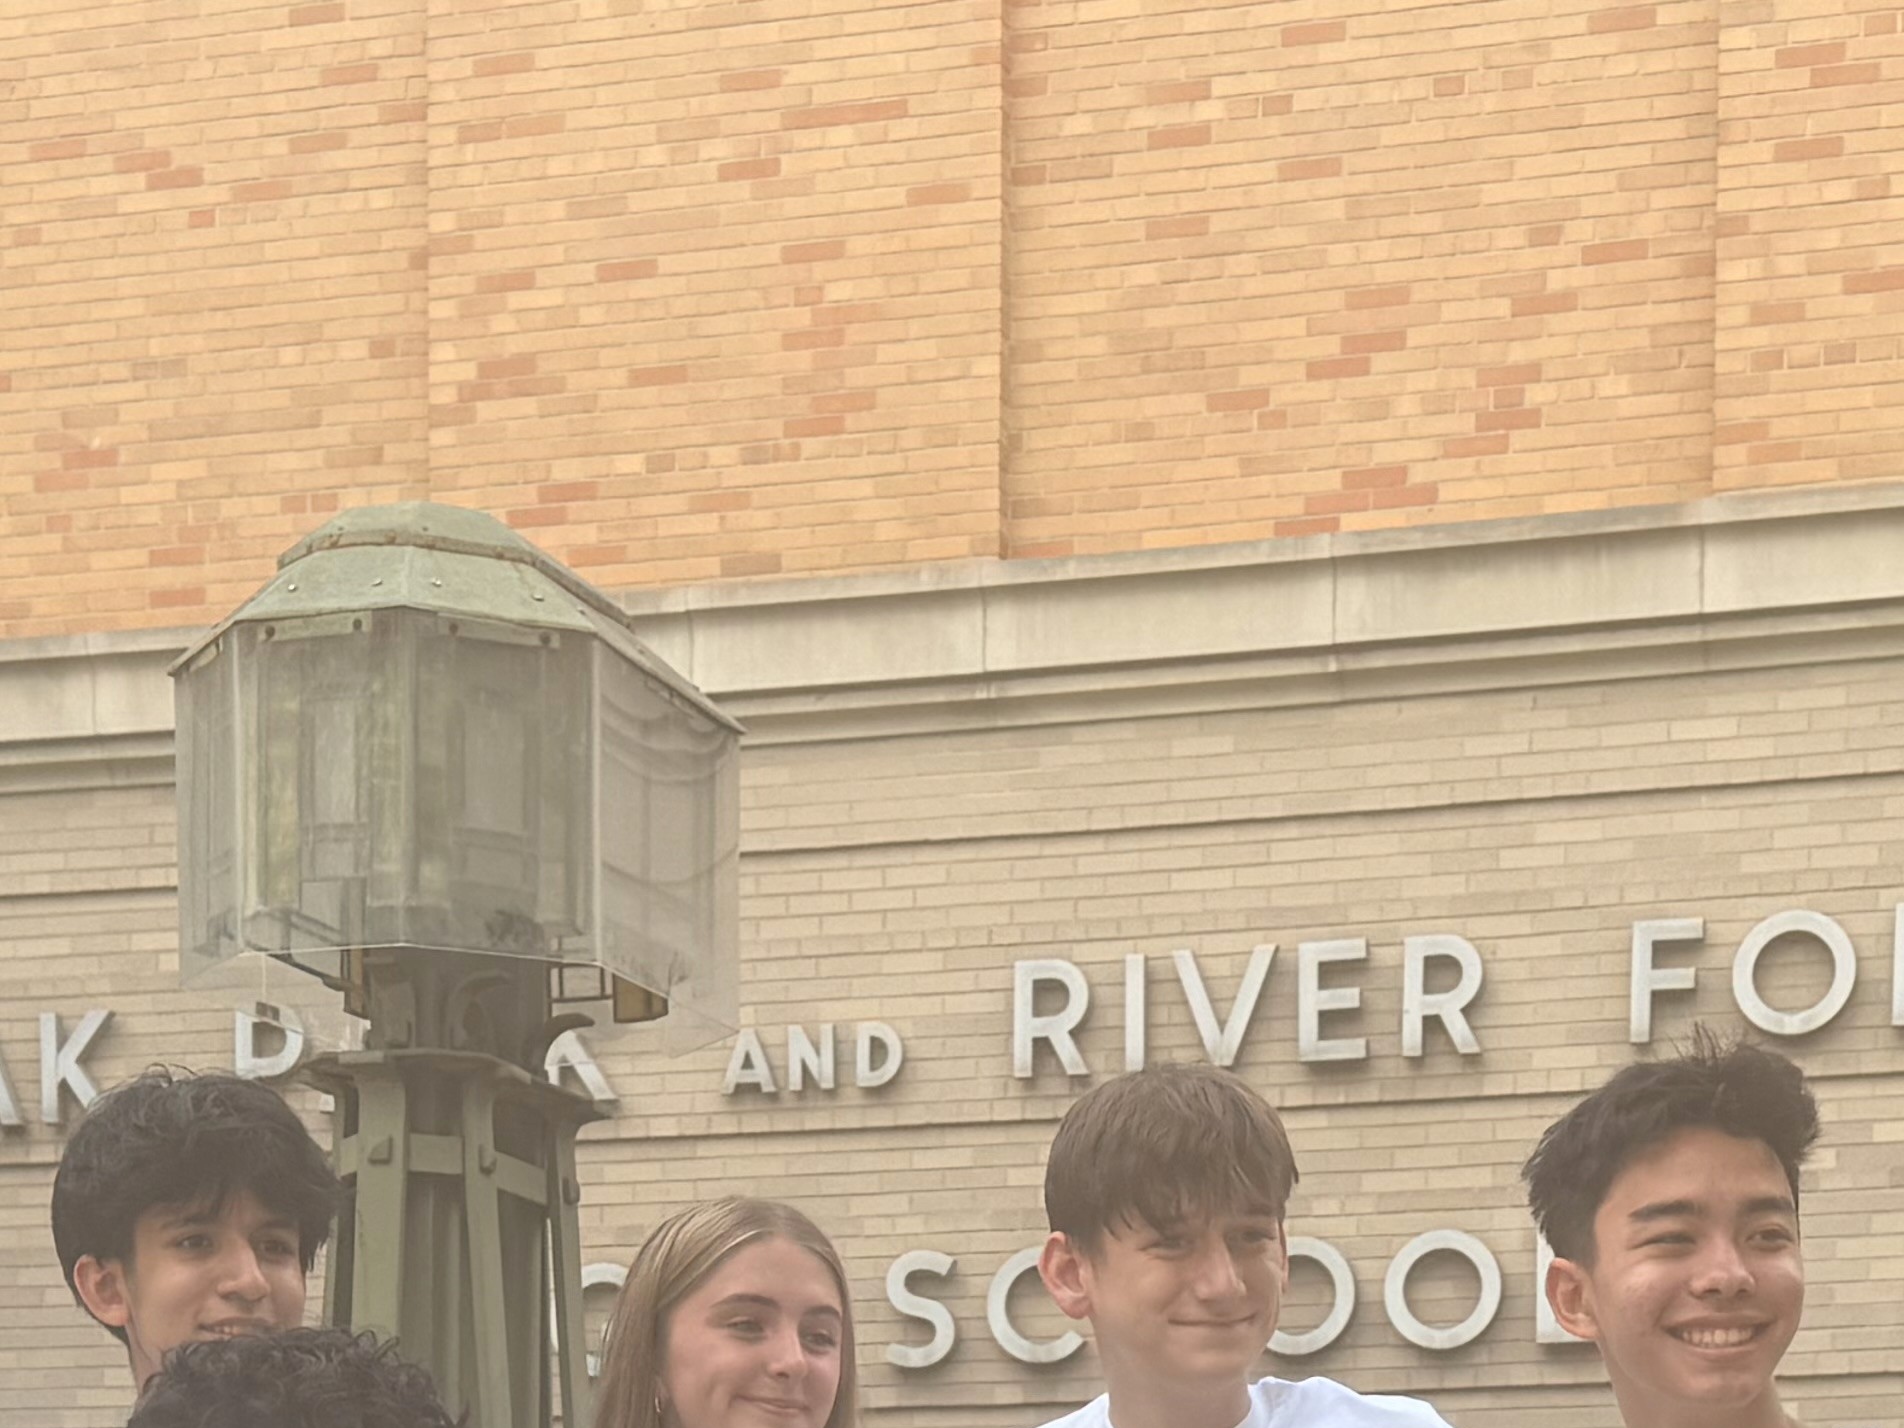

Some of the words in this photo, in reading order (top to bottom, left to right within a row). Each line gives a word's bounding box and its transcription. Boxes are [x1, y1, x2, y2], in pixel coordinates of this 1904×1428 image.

[721, 1021, 903, 1095] AND
[1012, 933, 1484, 1079] RIVER
[885, 1224, 1599, 1369] SCOOL
